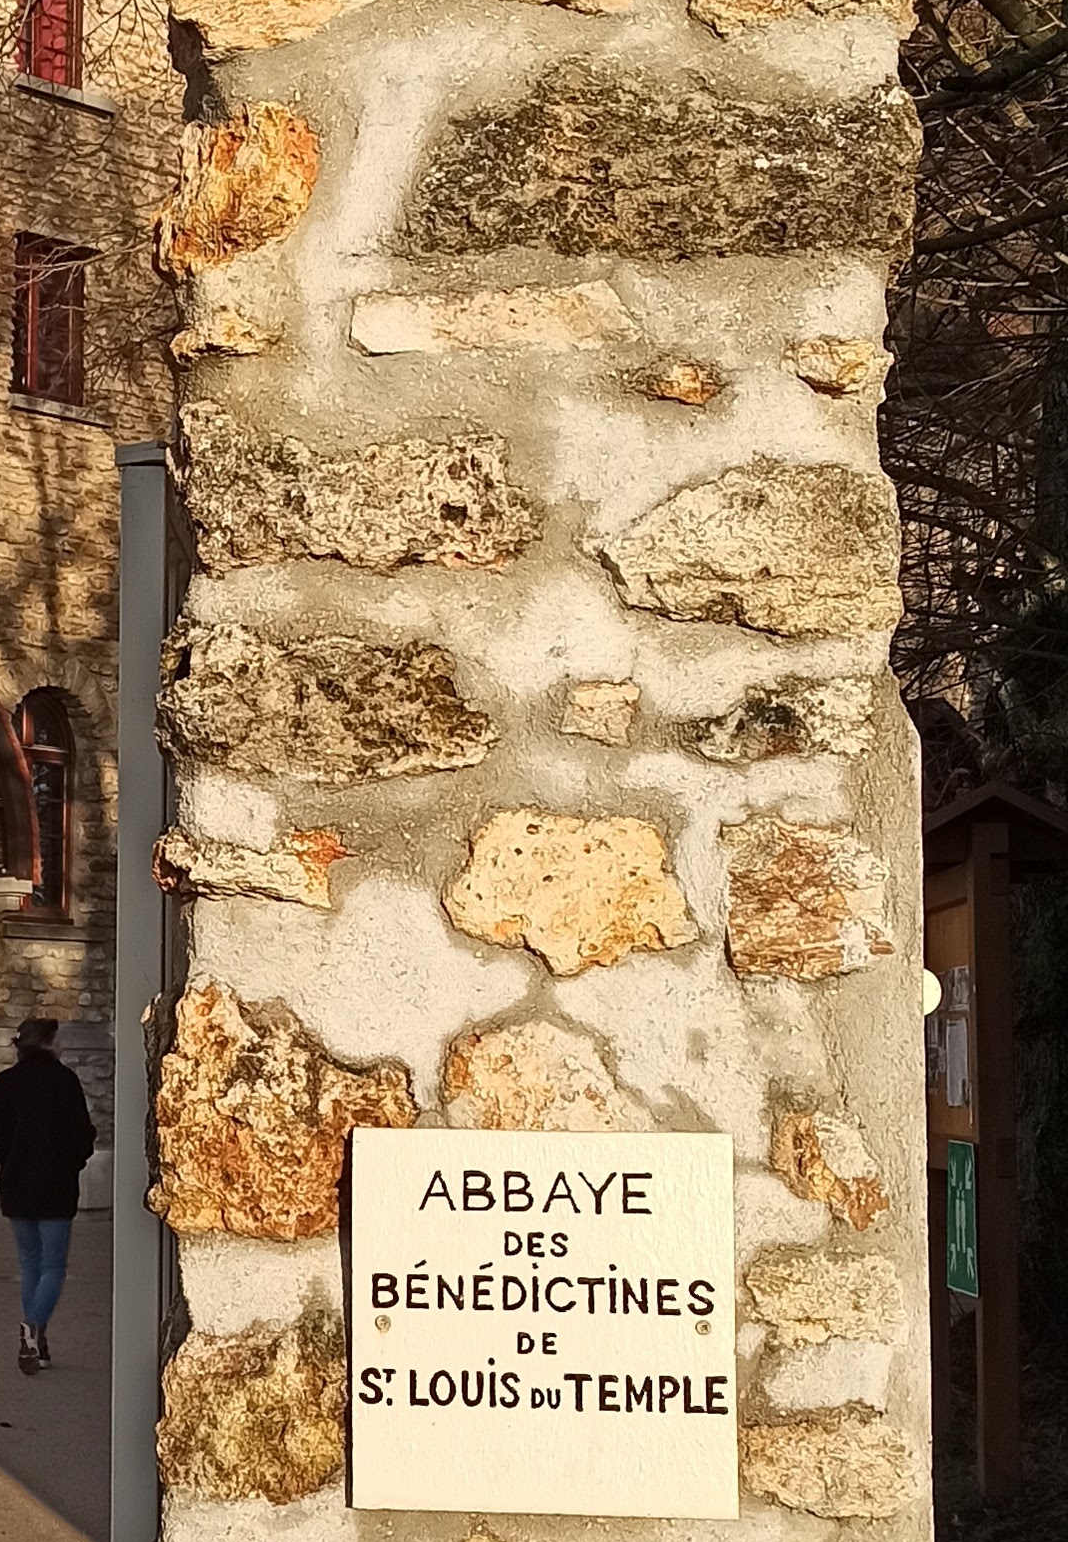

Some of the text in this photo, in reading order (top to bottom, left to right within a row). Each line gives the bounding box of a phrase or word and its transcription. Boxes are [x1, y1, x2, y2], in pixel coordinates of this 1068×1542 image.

[419, 1170, 653, 1215] ABBAYE
[504, 1231, 569, 1258] DES
[372, 1260, 716, 1317] BÉNÉDICTINES
[517, 1332, 558, 1356] DE
[410, 1358, 521, 1409] LOUIS
[531, 1387, 561, 1410] DU
[564, 1373, 729, 1415] TEMPLE
